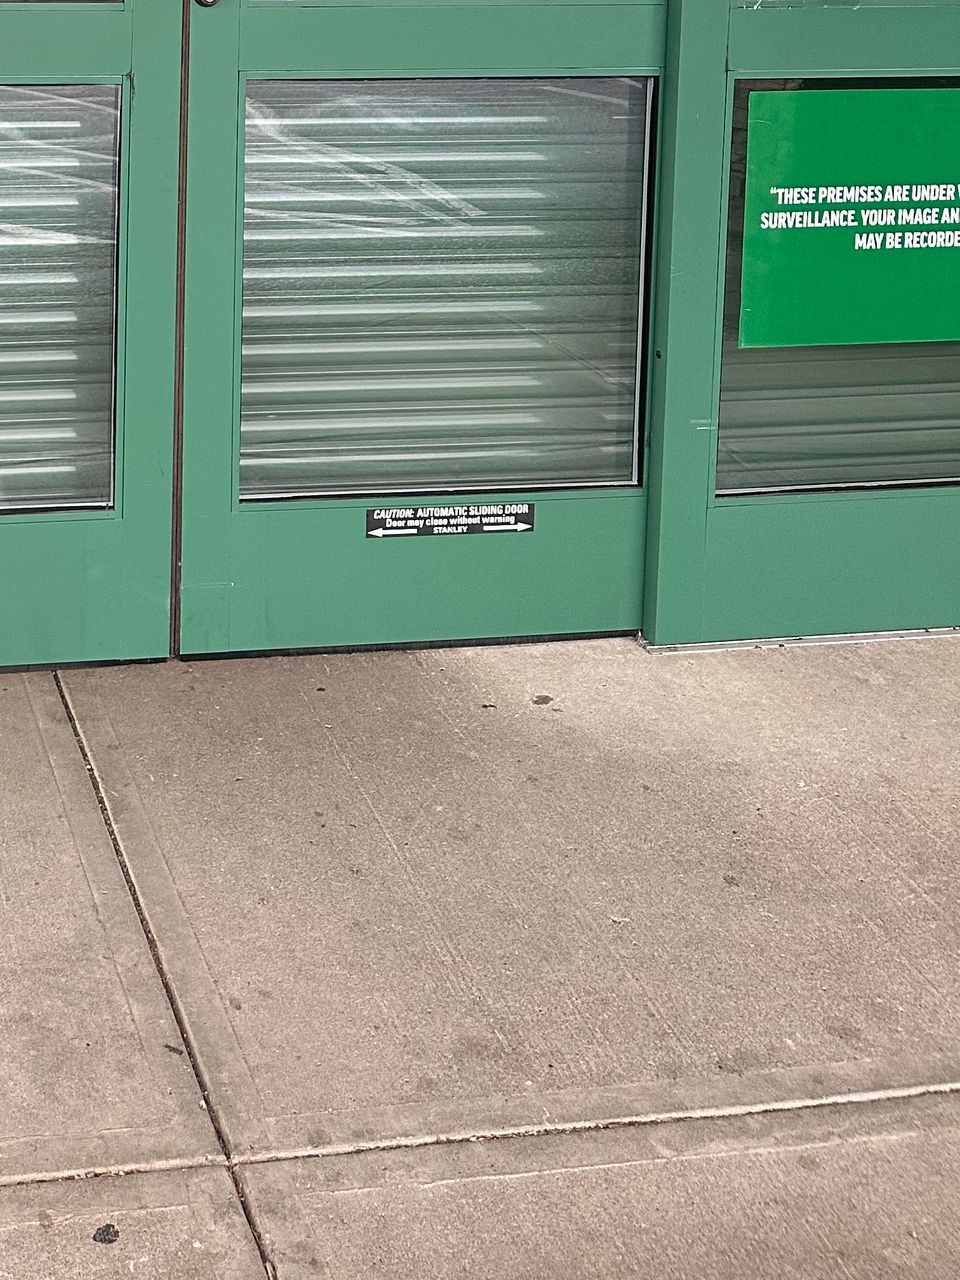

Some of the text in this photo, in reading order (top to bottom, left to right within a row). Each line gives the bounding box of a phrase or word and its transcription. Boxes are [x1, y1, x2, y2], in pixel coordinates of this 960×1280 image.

[818, 186, 882, 203] PREMISES
[884, 185, 909, 202] ARE
[912, 184, 954, 201] UNDER
[861, 209, 895, 226] YOUR
[897, 209, 939, 225] IMAGE
[854, 233, 882, 250] MAY
[886, 233, 902, 248] BE
[374, 504, 528, 519] CAUTION: AUTOMATIC SLIDING DOOR
[386, 514, 515, 528] Door may close without warning
[433, 526, 468, 534] STANLEY
